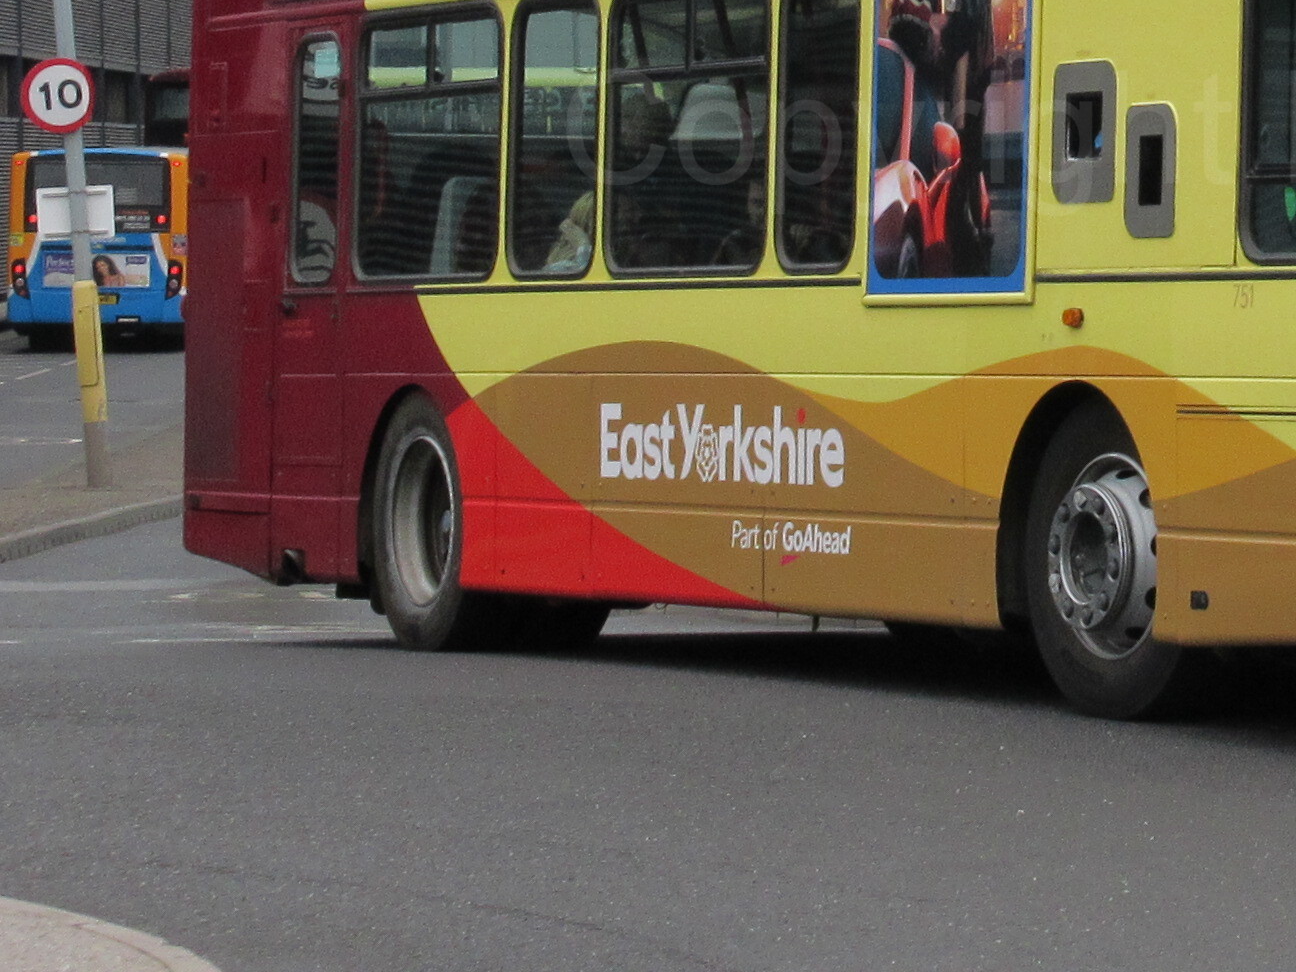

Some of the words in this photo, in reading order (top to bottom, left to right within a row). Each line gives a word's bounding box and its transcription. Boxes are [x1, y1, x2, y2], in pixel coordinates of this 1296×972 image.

[38, 78, 83, 111] 10
[1232, 283, 1254, 308] 751
[731, 519, 759, 550] Part
[764, 521, 780, 551] of
[782, 521, 852, 555] GoAhead
